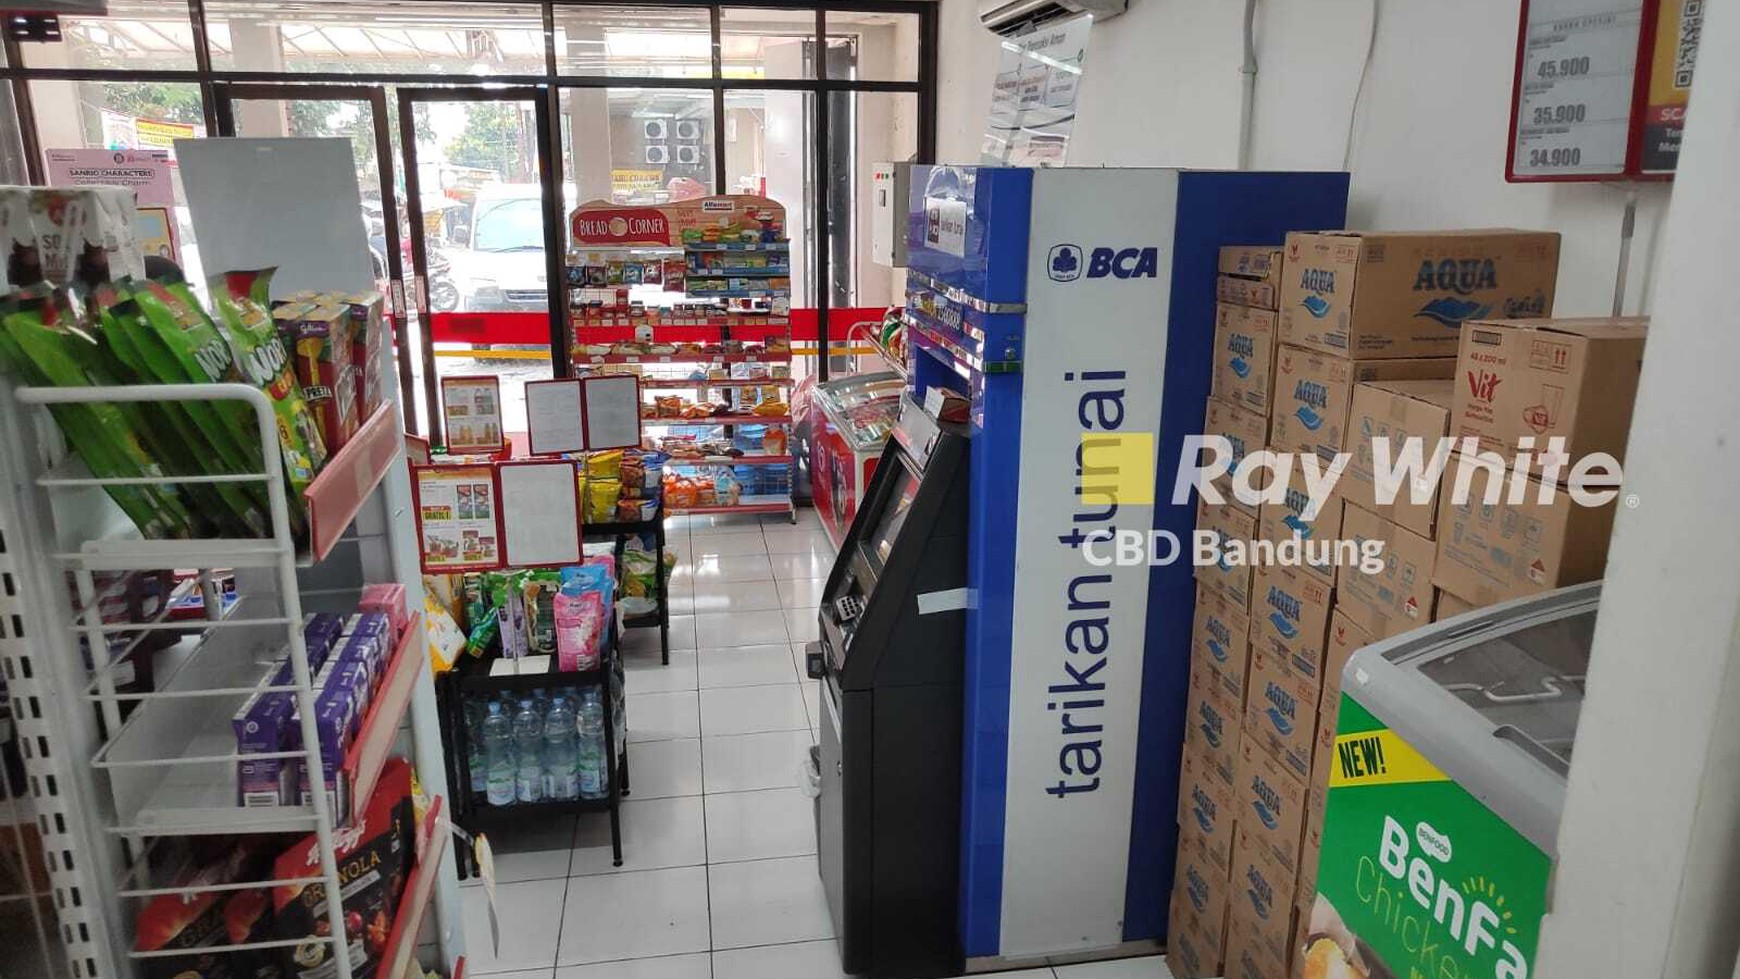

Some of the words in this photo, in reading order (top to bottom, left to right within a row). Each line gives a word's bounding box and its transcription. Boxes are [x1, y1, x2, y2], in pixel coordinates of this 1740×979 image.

[1538, 56, 1590, 79] 45.900
[1533, 104, 1586, 125] 35.900
[69, 169, 98, 177] SANRIO
[101, 169, 152, 177] CHARACTERS
[1530, 148, 1581, 166] 34.900
[579, 219, 608, 236] BREAD
[628, 218, 665, 235] CORNER
[1086, 247, 1158, 279] BCA
[1412, 257, 1498, 296] AQUA
[1300, 268, 1336, 296] AQUA
[1228, 333, 1254, 360] AQUA
[1293, 379, 1327, 409] AQUA
[1468, 368, 1502, 403] Vit
[1058, 371, 1126, 548] tunai
[1266, 585, 1302, 622] AQUA
[1045, 574, 1113, 799] tarikan
[1264, 681, 1296, 720] AQUA
[1337, 736, 1387, 779] NEW!
[303, 850, 382, 908] GRNOLA
[1356, 855, 1470, 979] Chicke
